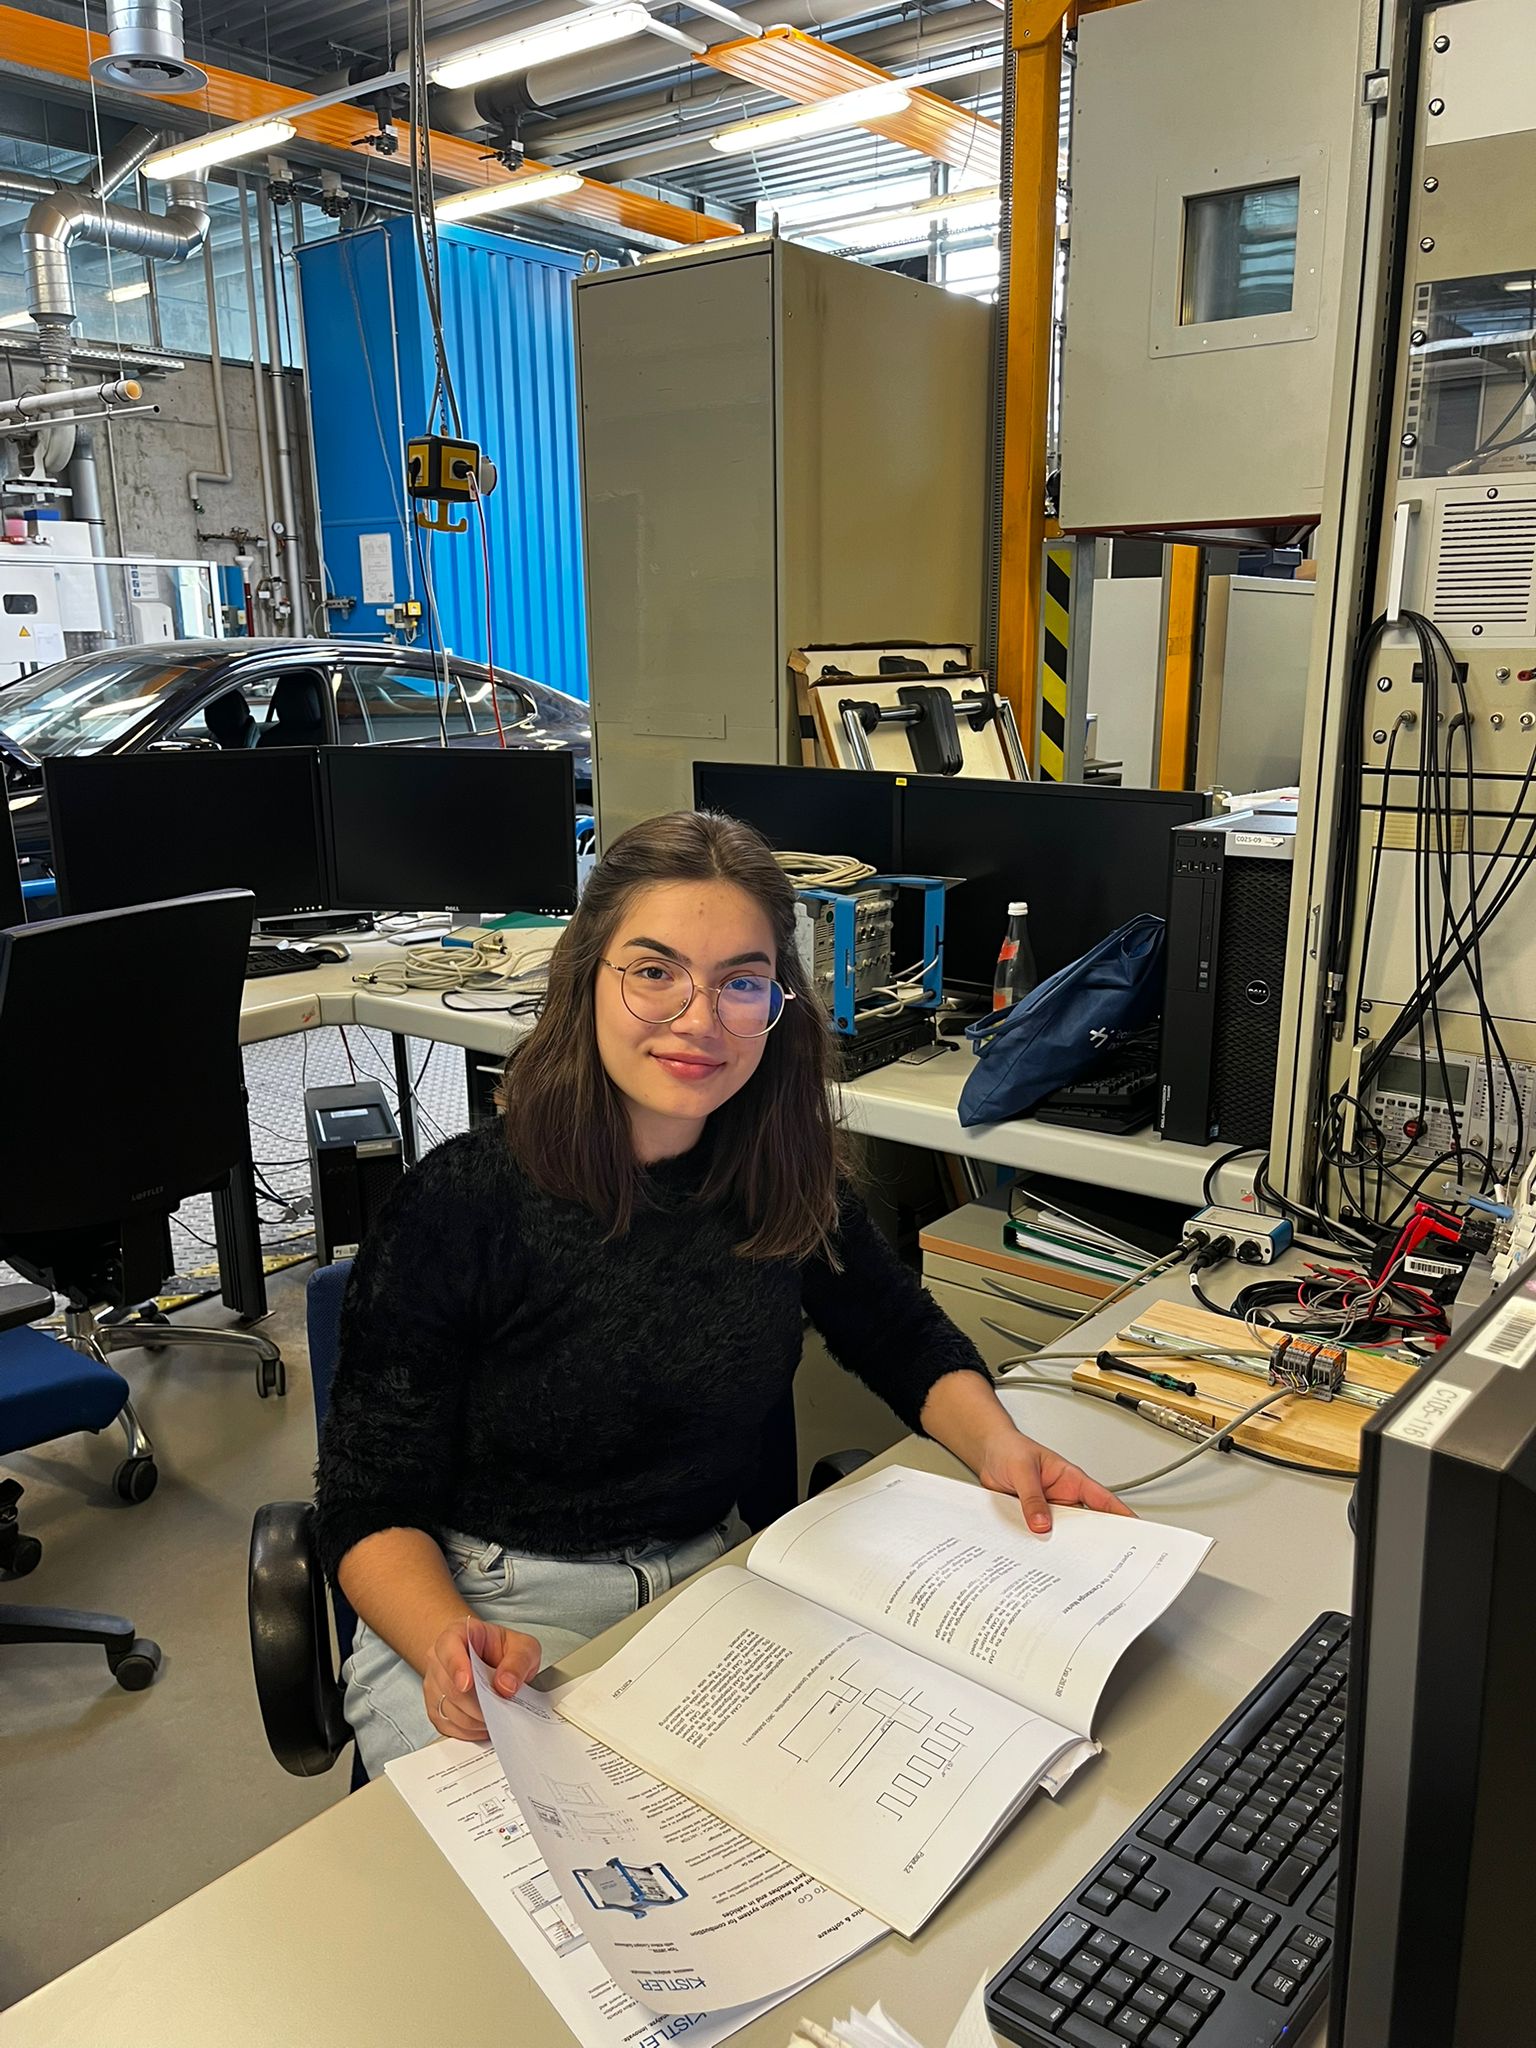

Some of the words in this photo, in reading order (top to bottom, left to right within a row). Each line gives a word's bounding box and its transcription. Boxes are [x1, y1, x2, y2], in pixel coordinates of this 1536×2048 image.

[1403, 1389, 1458, 1438] C105-116
[767, 1879, 794, 1896] benches
[791, 1882, 805, 1893] and
[812, 1883, 827, 1895] To
[747, 1899, 756, 1907] in
[754, 1892, 768, 1903] and
[759, 1889, 792, 1910] evaluation
[796, 1892, 813, 1905] Go
[721, 1903, 748, 1919] vehicles
[736, 1905, 760, 1921] system
[690, 1922, 727, 1936] combustion
[726, 1917, 737, 1925] for
[816, 1919, 845, 1940] software
[637, 1975, 706, 1991] KISTLER
[620, 2025, 647, 2044] innovate.
